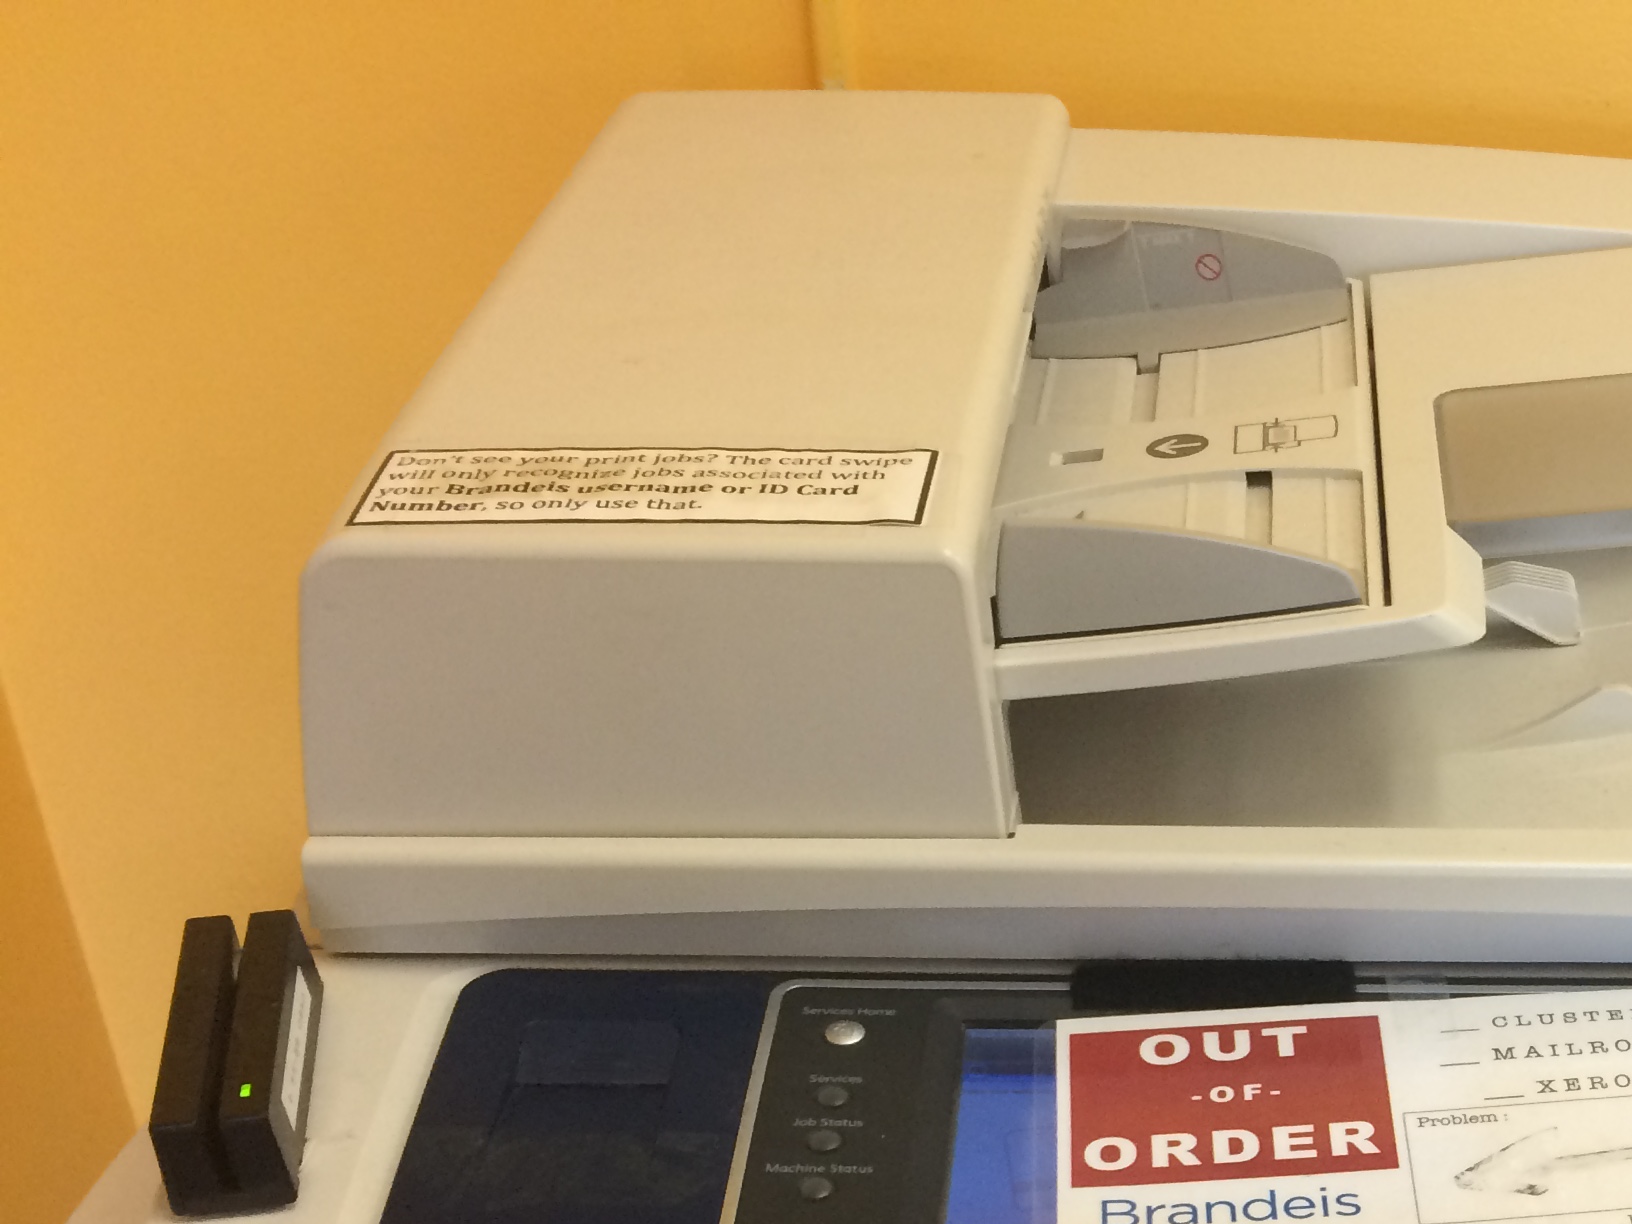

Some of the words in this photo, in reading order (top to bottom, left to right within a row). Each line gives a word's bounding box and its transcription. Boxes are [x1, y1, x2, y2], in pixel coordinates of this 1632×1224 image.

[396, 454, 463, 466] Don't
[470, 455, 512, 465] see
[517, 455, 580, 466] your
[584, 454, 647, 467] print
[652, 453, 719, 465] jobs?
[726, 454, 772, 465] The
[778, 455, 832, 466] card
[839, 456, 914, 468] swipe
[388, 469, 435, 481] will
[441, 468, 497, 482] only
[503, 467, 626, 482] recognize
[631, 467, 685, 480] jobs
[691, 468, 823, 480] associated
[831, 469, 886, 480] with
[375, 484, 440, 499] your
[445, 481, 571, 496] Brandeis
[577, 482, 714, 494] username
[721, 484, 752, 494] or
[758, 483, 789, 495] ID
[796, 483, 860, 496] Card
[369, 500, 488, 512] Number,
[495, 500, 524, 511] so
[531, 499, 588, 512] only
[595, 499, 639, 509] use
[646, 498, 703, 510] that.
[1139, 1025, 1308, 1066] OUT
[1191, 1083, 1281, 1103] -OF-
[1083, 1120, 1382, 1171] ORDER
[765, 1163, 825, 1174] Machine
[830, 1163, 874, 1174] Status
